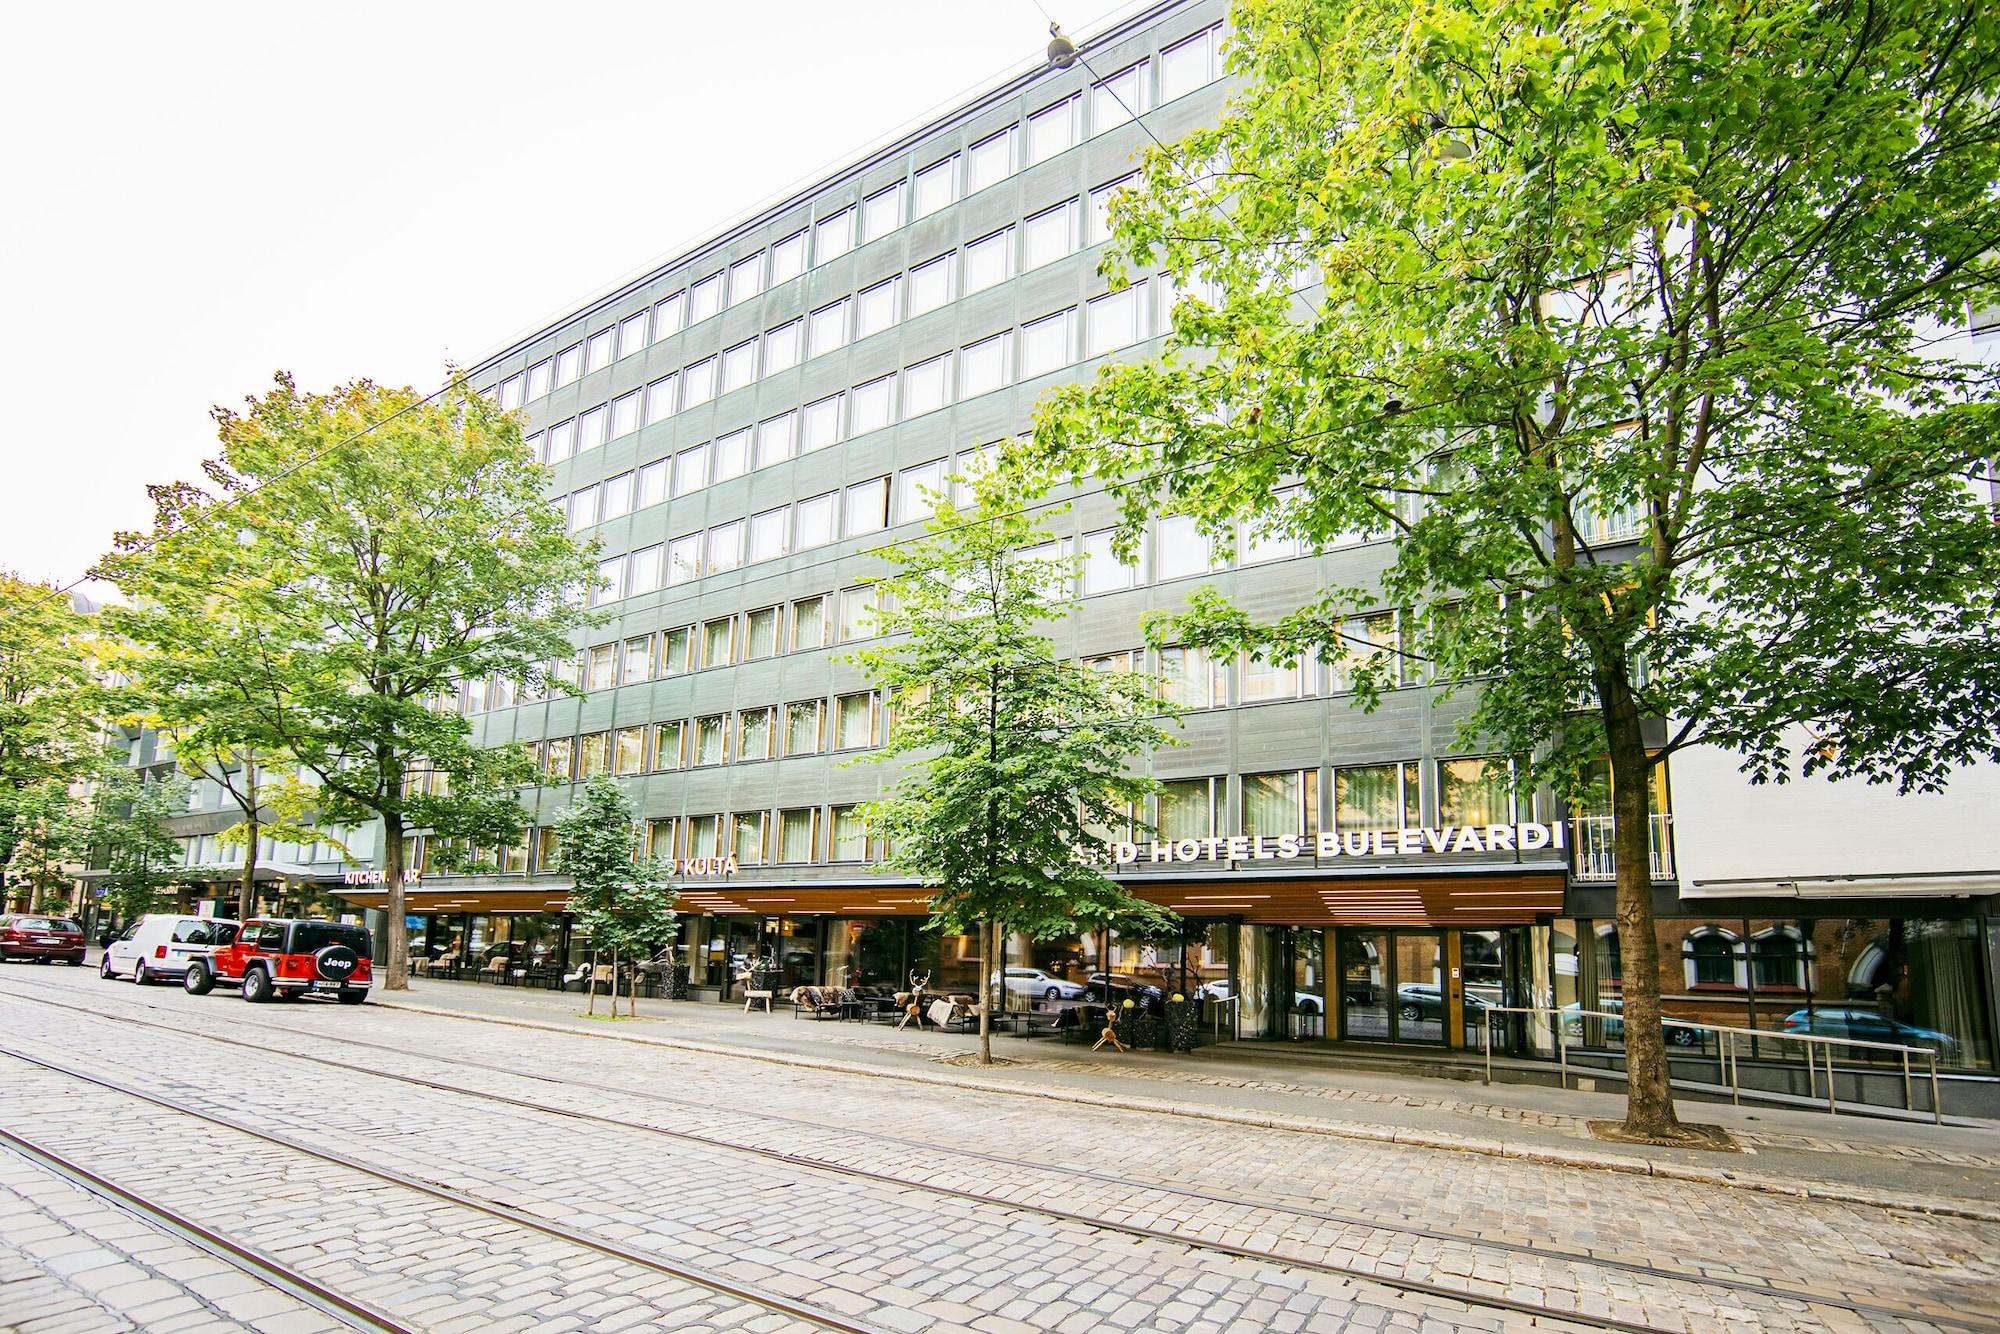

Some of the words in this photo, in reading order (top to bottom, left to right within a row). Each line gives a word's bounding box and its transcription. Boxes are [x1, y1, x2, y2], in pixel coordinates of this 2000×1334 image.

[1150, 834, 1300, 863] HOTELS
[1316, 821, 1564, 857] BULEVARDI
[344, 869, 388, 885] KITCHEN
[324, 957, 352, 969] Jeep
